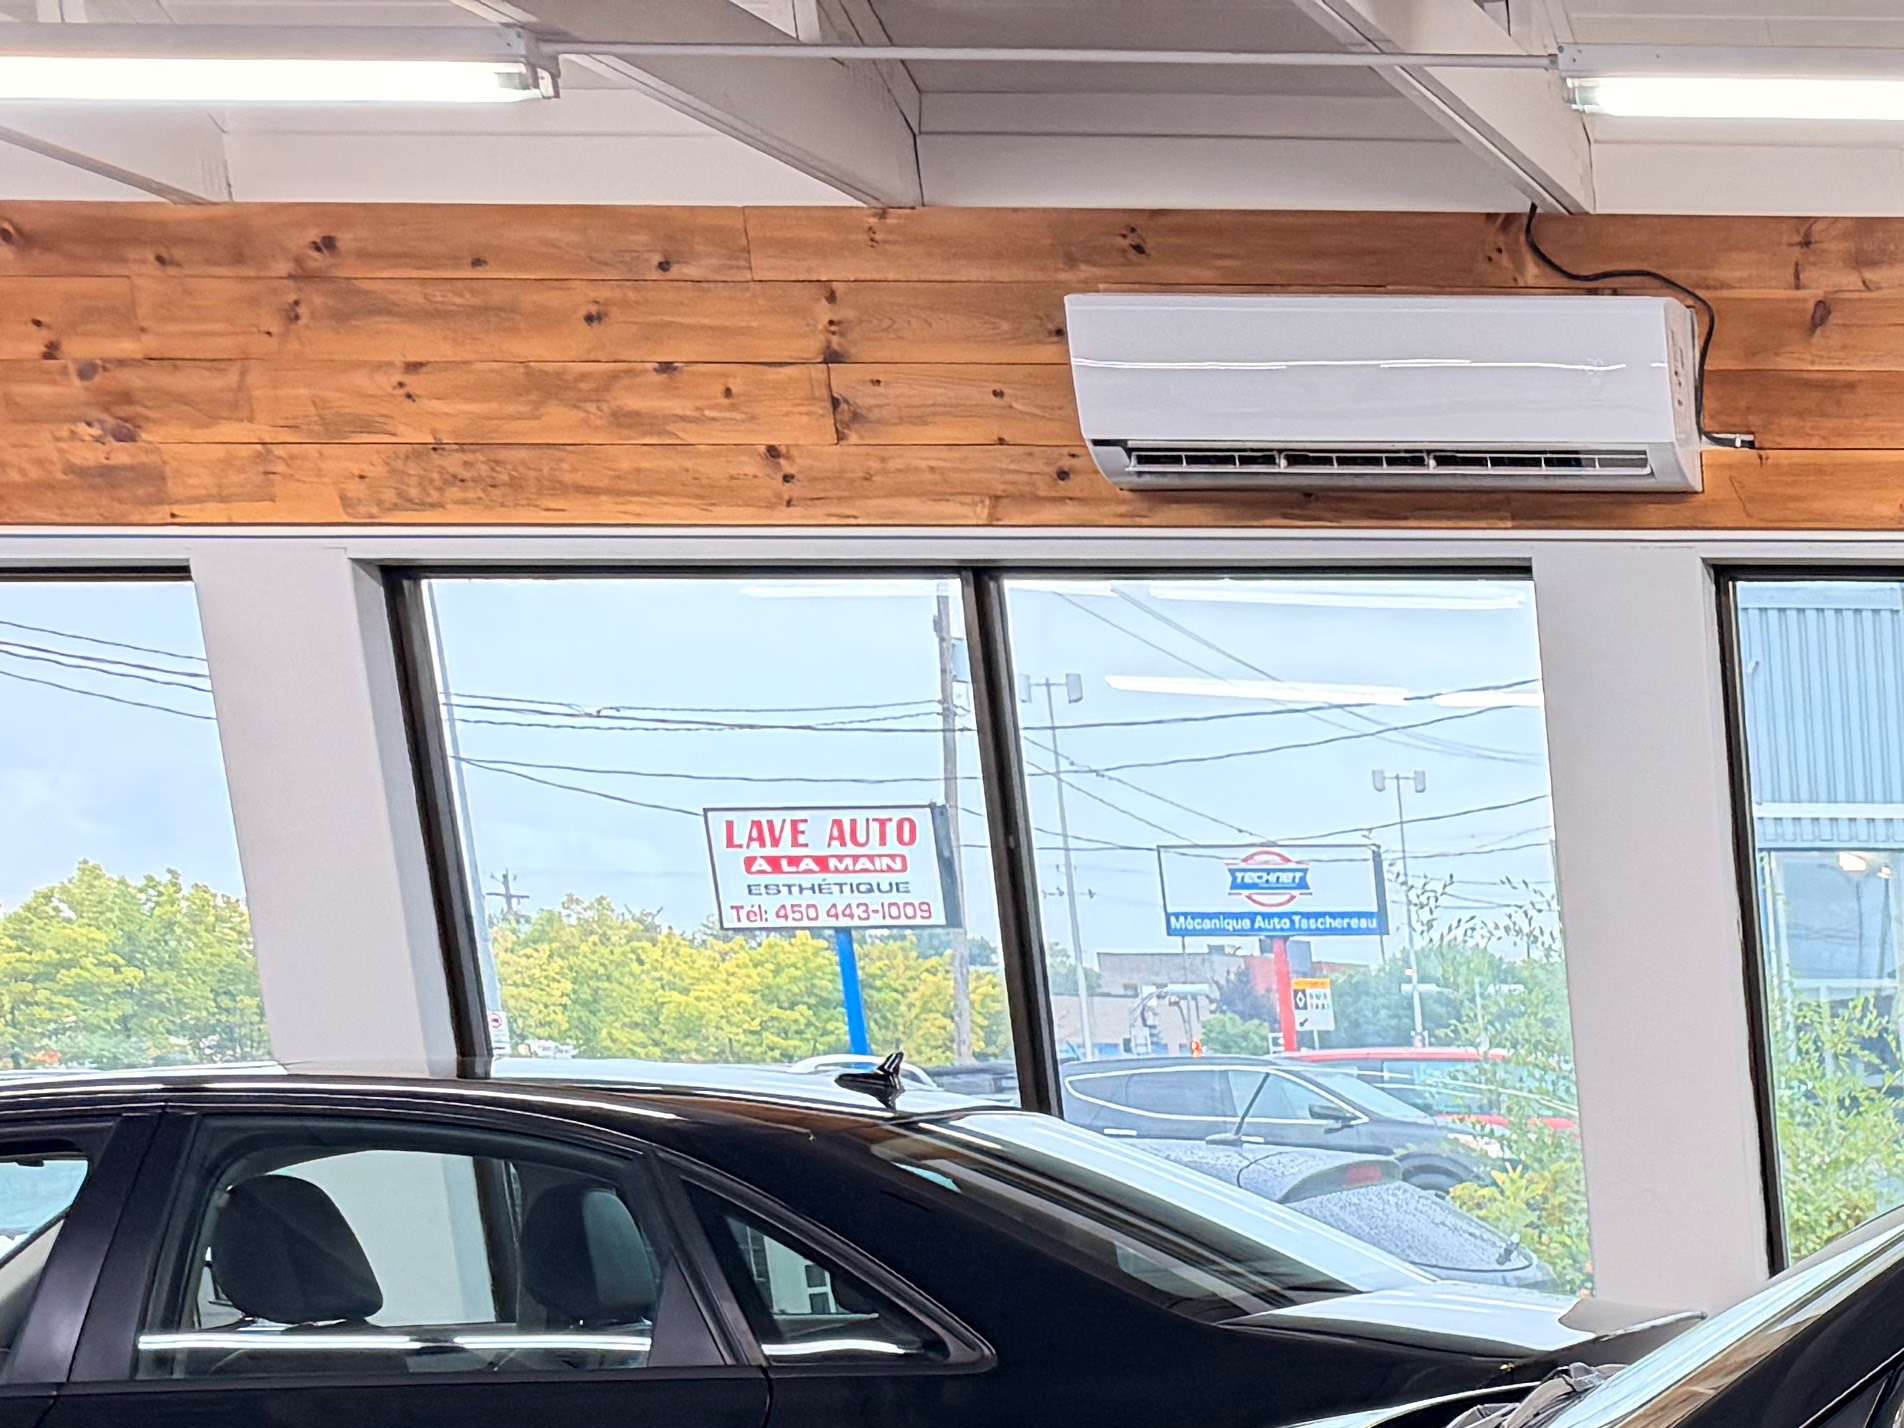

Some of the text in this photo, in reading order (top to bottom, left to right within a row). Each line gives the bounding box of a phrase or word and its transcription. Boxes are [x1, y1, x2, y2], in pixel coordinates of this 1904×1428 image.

[725, 816, 917, 849] LAVE AUTO
[779, 857, 820, 872] LA
[828, 856, 902, 871] MAIN
[747, 878, 911, 896] ESTHÉTIQUE
[730, 902, 932, 923] Tél: 450 443-1009
[1170, 914, 1251, 931] Mécanique
[1254, 914, 1290, 929] Auto
